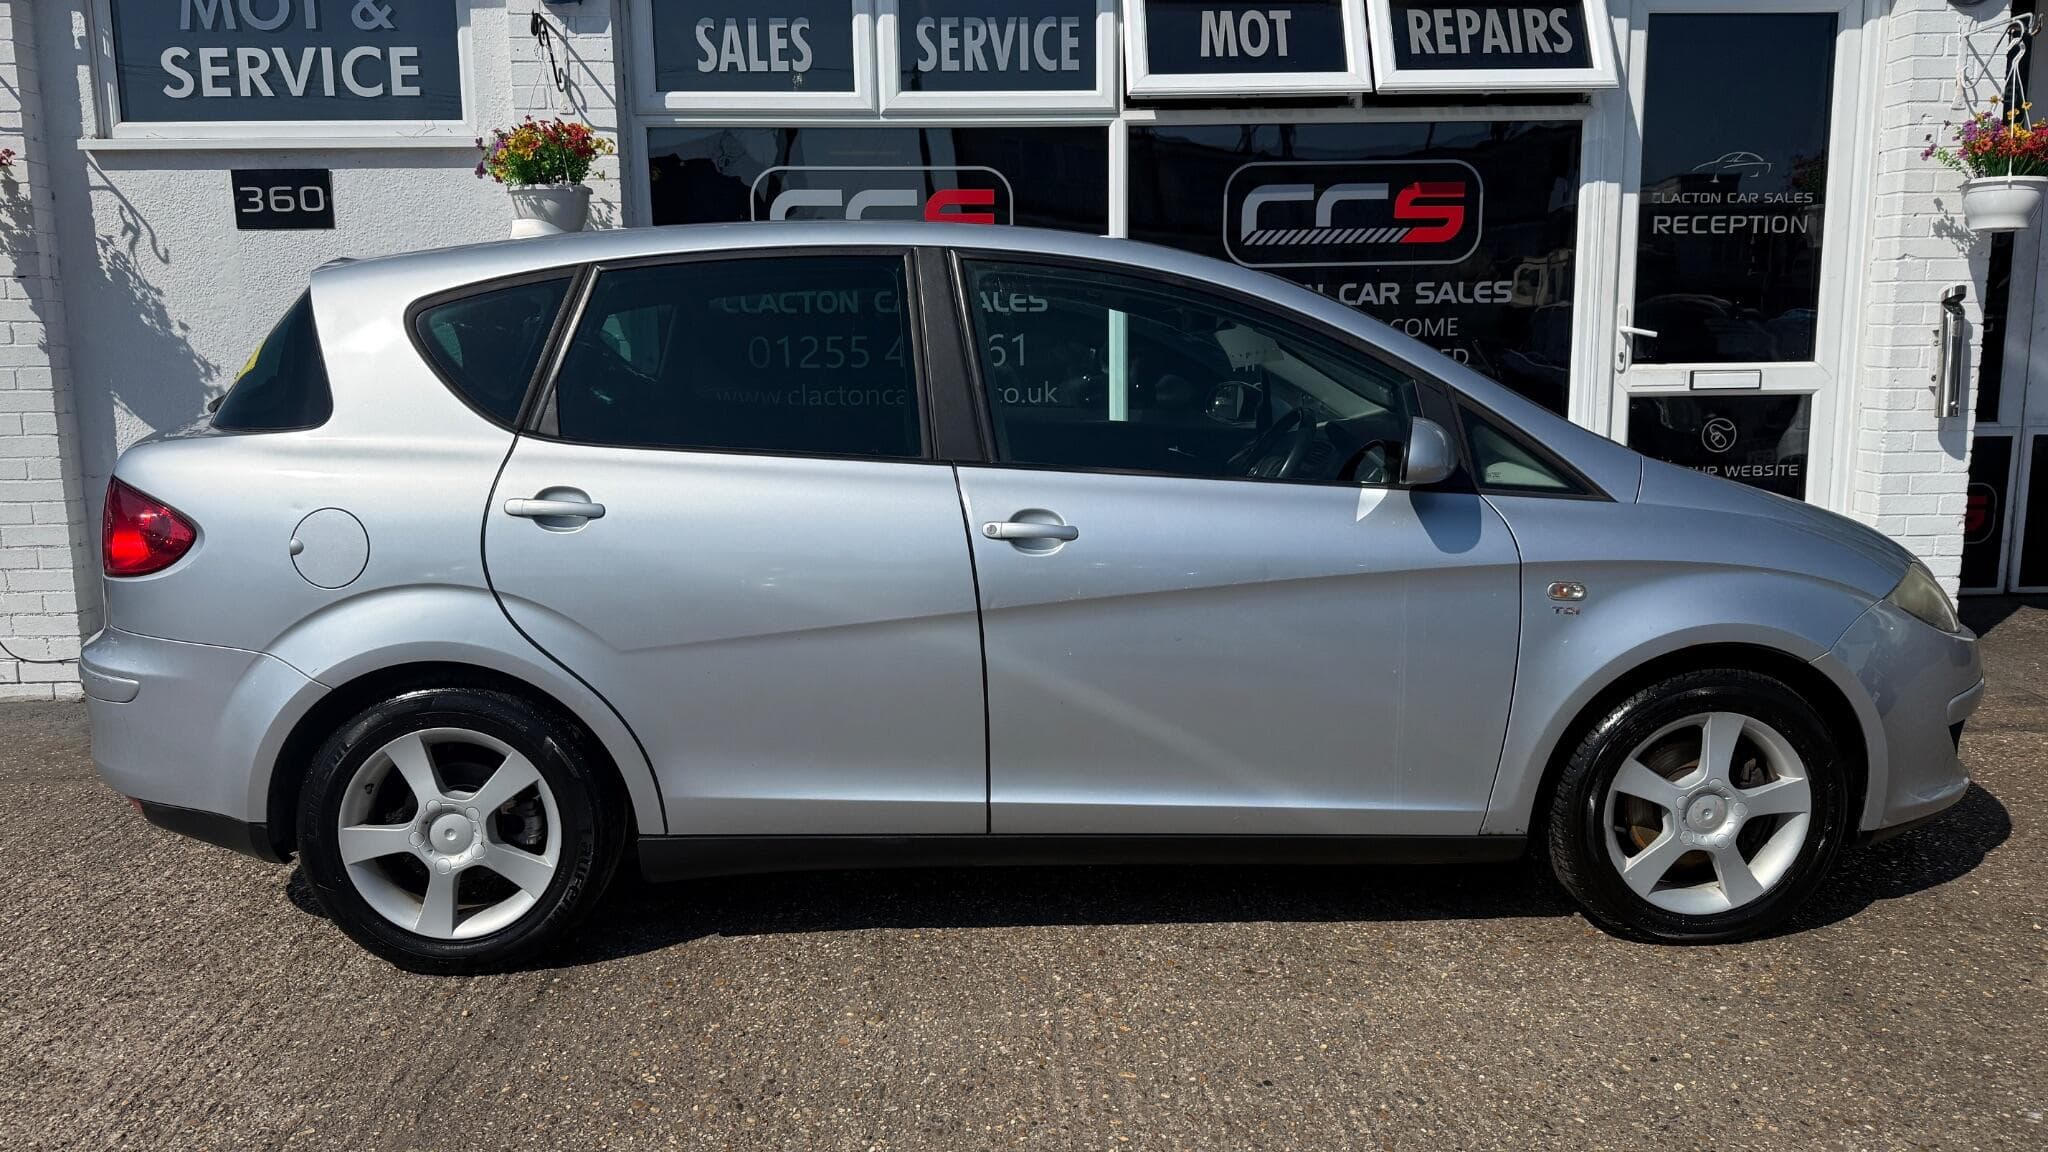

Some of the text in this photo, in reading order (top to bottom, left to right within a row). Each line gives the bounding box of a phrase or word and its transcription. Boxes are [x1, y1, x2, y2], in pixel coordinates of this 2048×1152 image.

[696, 17, 812, 74] SALES
[916, 16, 1080, 73] SERVICE
[1200, 10, 1291, 57] MOT
[1408, 8, 1573, 54] REPAIRS
[160, 46, 421, 98] SERVICE
[239, 186, 325, 213] 360
[1652, 192, 1814, 204] CLACTON CAR SALES
[1653, 215, 1809, 235] RECEPTION
[721, 290, 858, 314] CLACTON
[1339, 282, 1400, 306] CAR
[1415, 280, 1513, 304] SALES
[748, 335, 870, 369] 01255
[1725, 464, 1799, 478] WEBSITE
